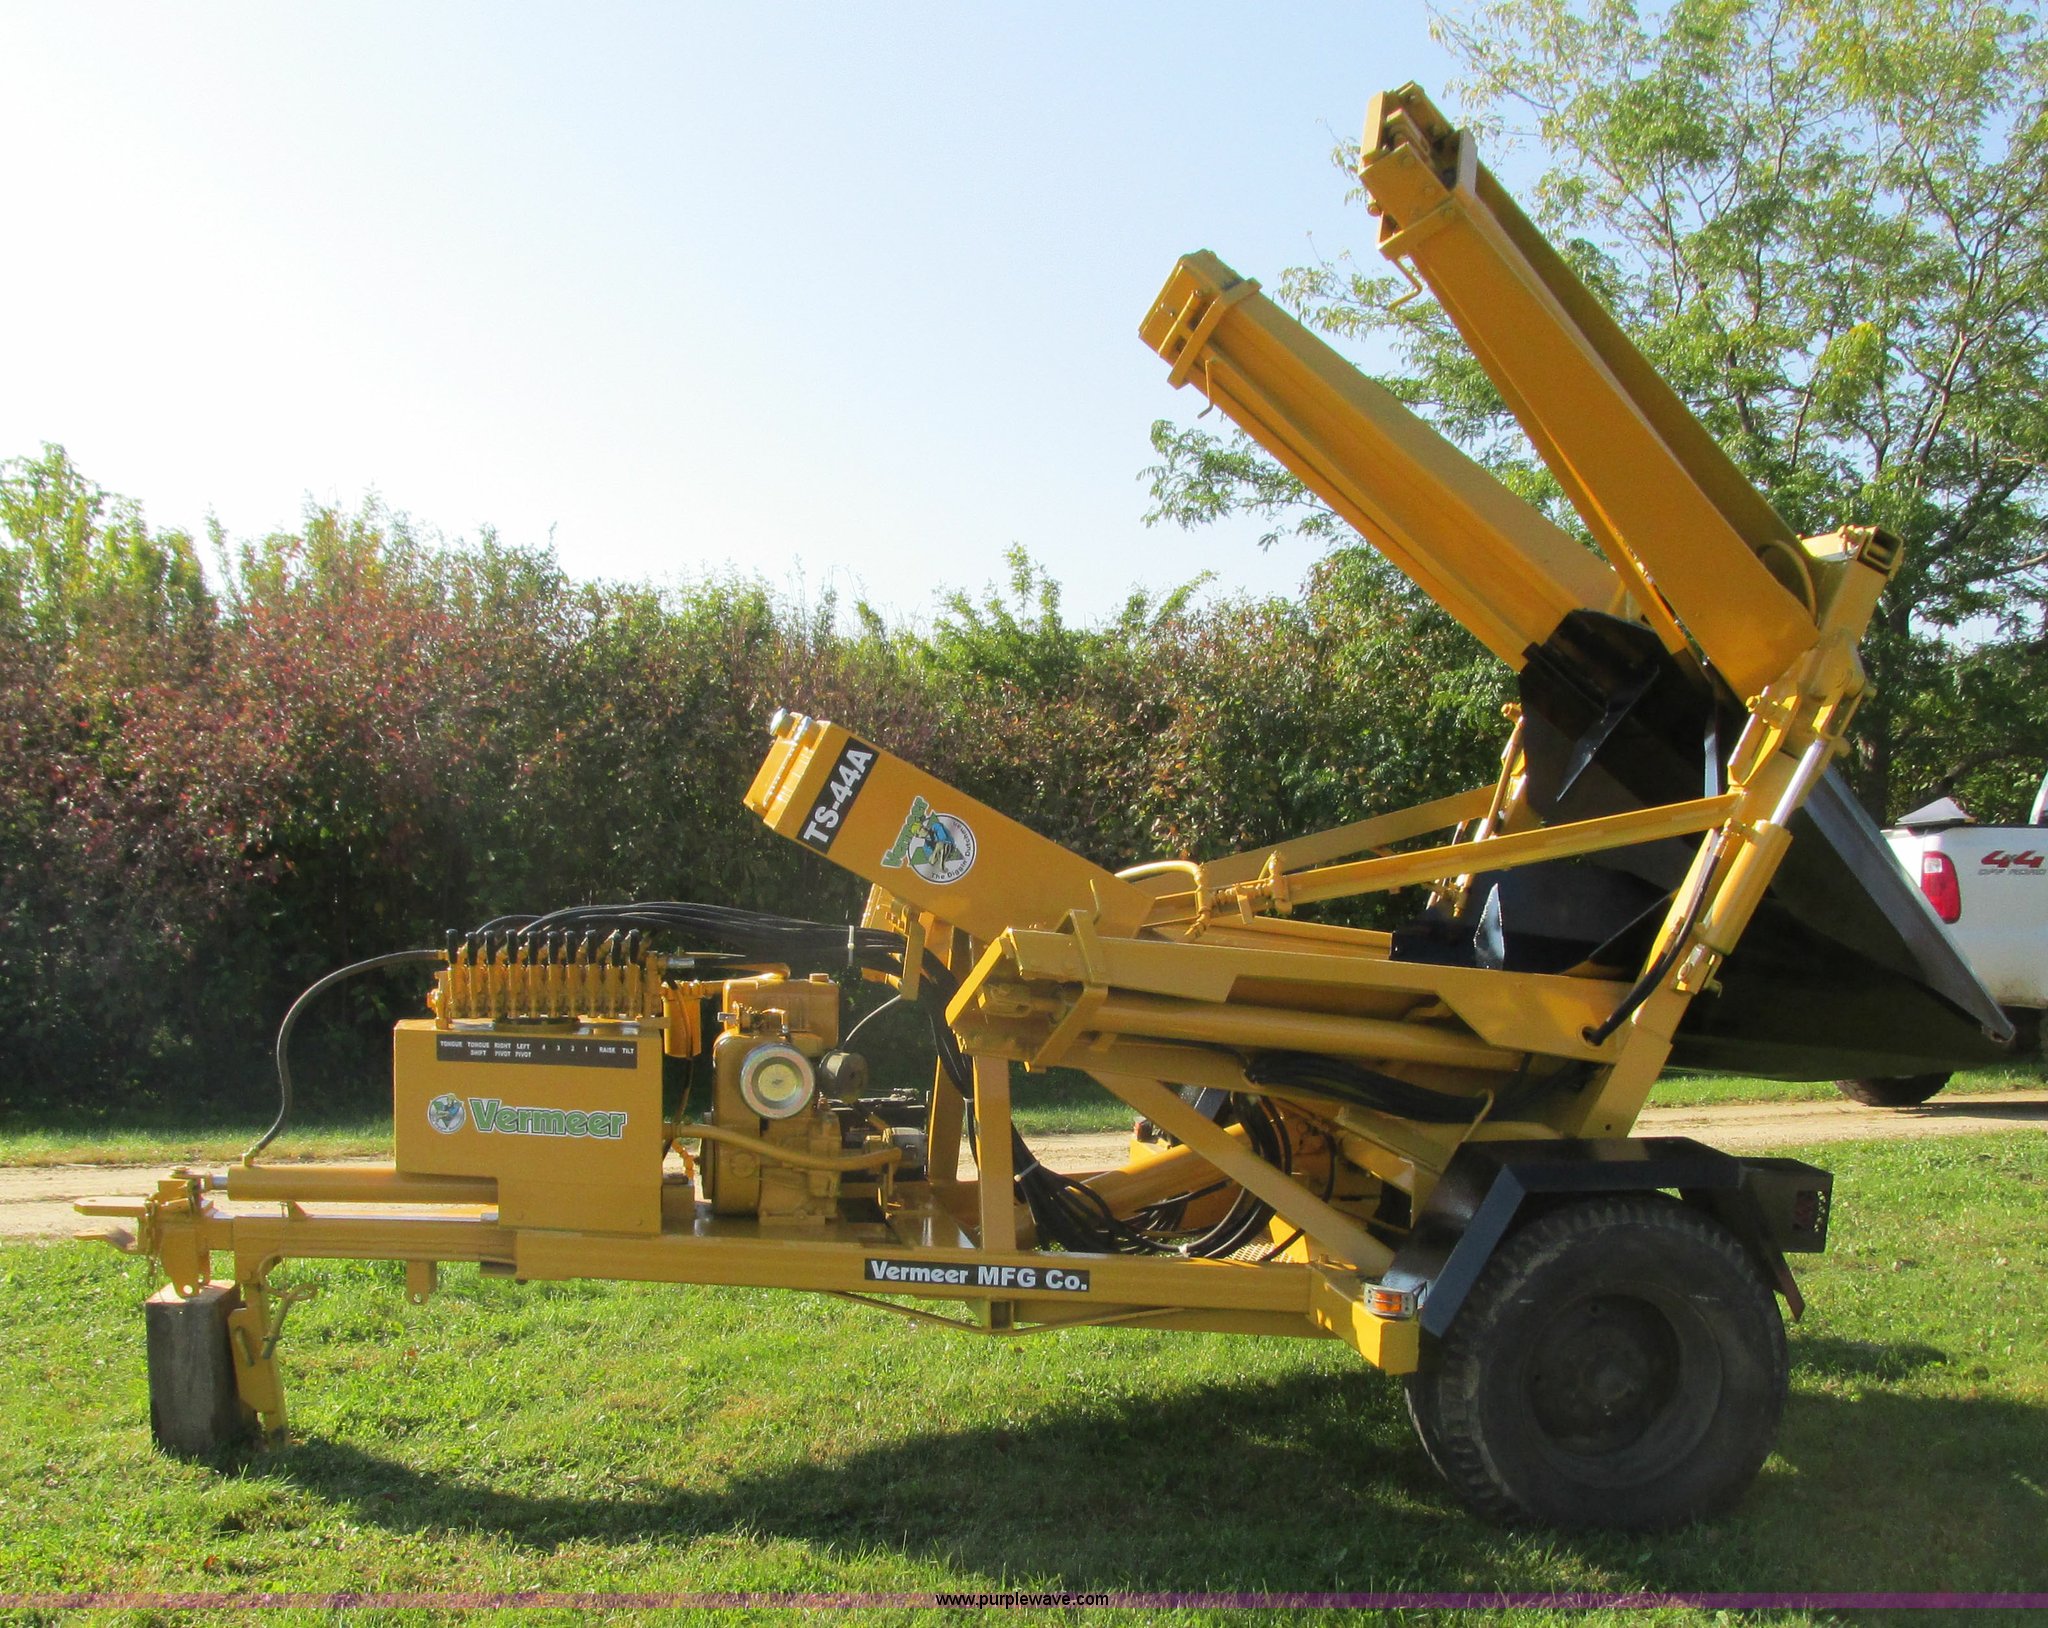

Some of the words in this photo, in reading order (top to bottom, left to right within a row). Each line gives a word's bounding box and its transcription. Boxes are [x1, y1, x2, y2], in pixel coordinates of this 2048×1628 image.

[803, 749, 873, 843] TS-44A
[931, 872, 946, 880] The
[952, 821, 971, 857] Dutchman
[440, 1040, 463, 1048] TONGUE
[467, 1041, 490, 1049] TONGUE
[556, 1044, 561, 1052] 3
[599, 1046, 616, 1054] RAISE
[469, 1098, 627, 1139] Vermeer
[871, 1260, 969, 1284] Vermeer
[977, 1266, 1036, 1288] MFG
[1045, 1269, 1088, 1291] Co.
